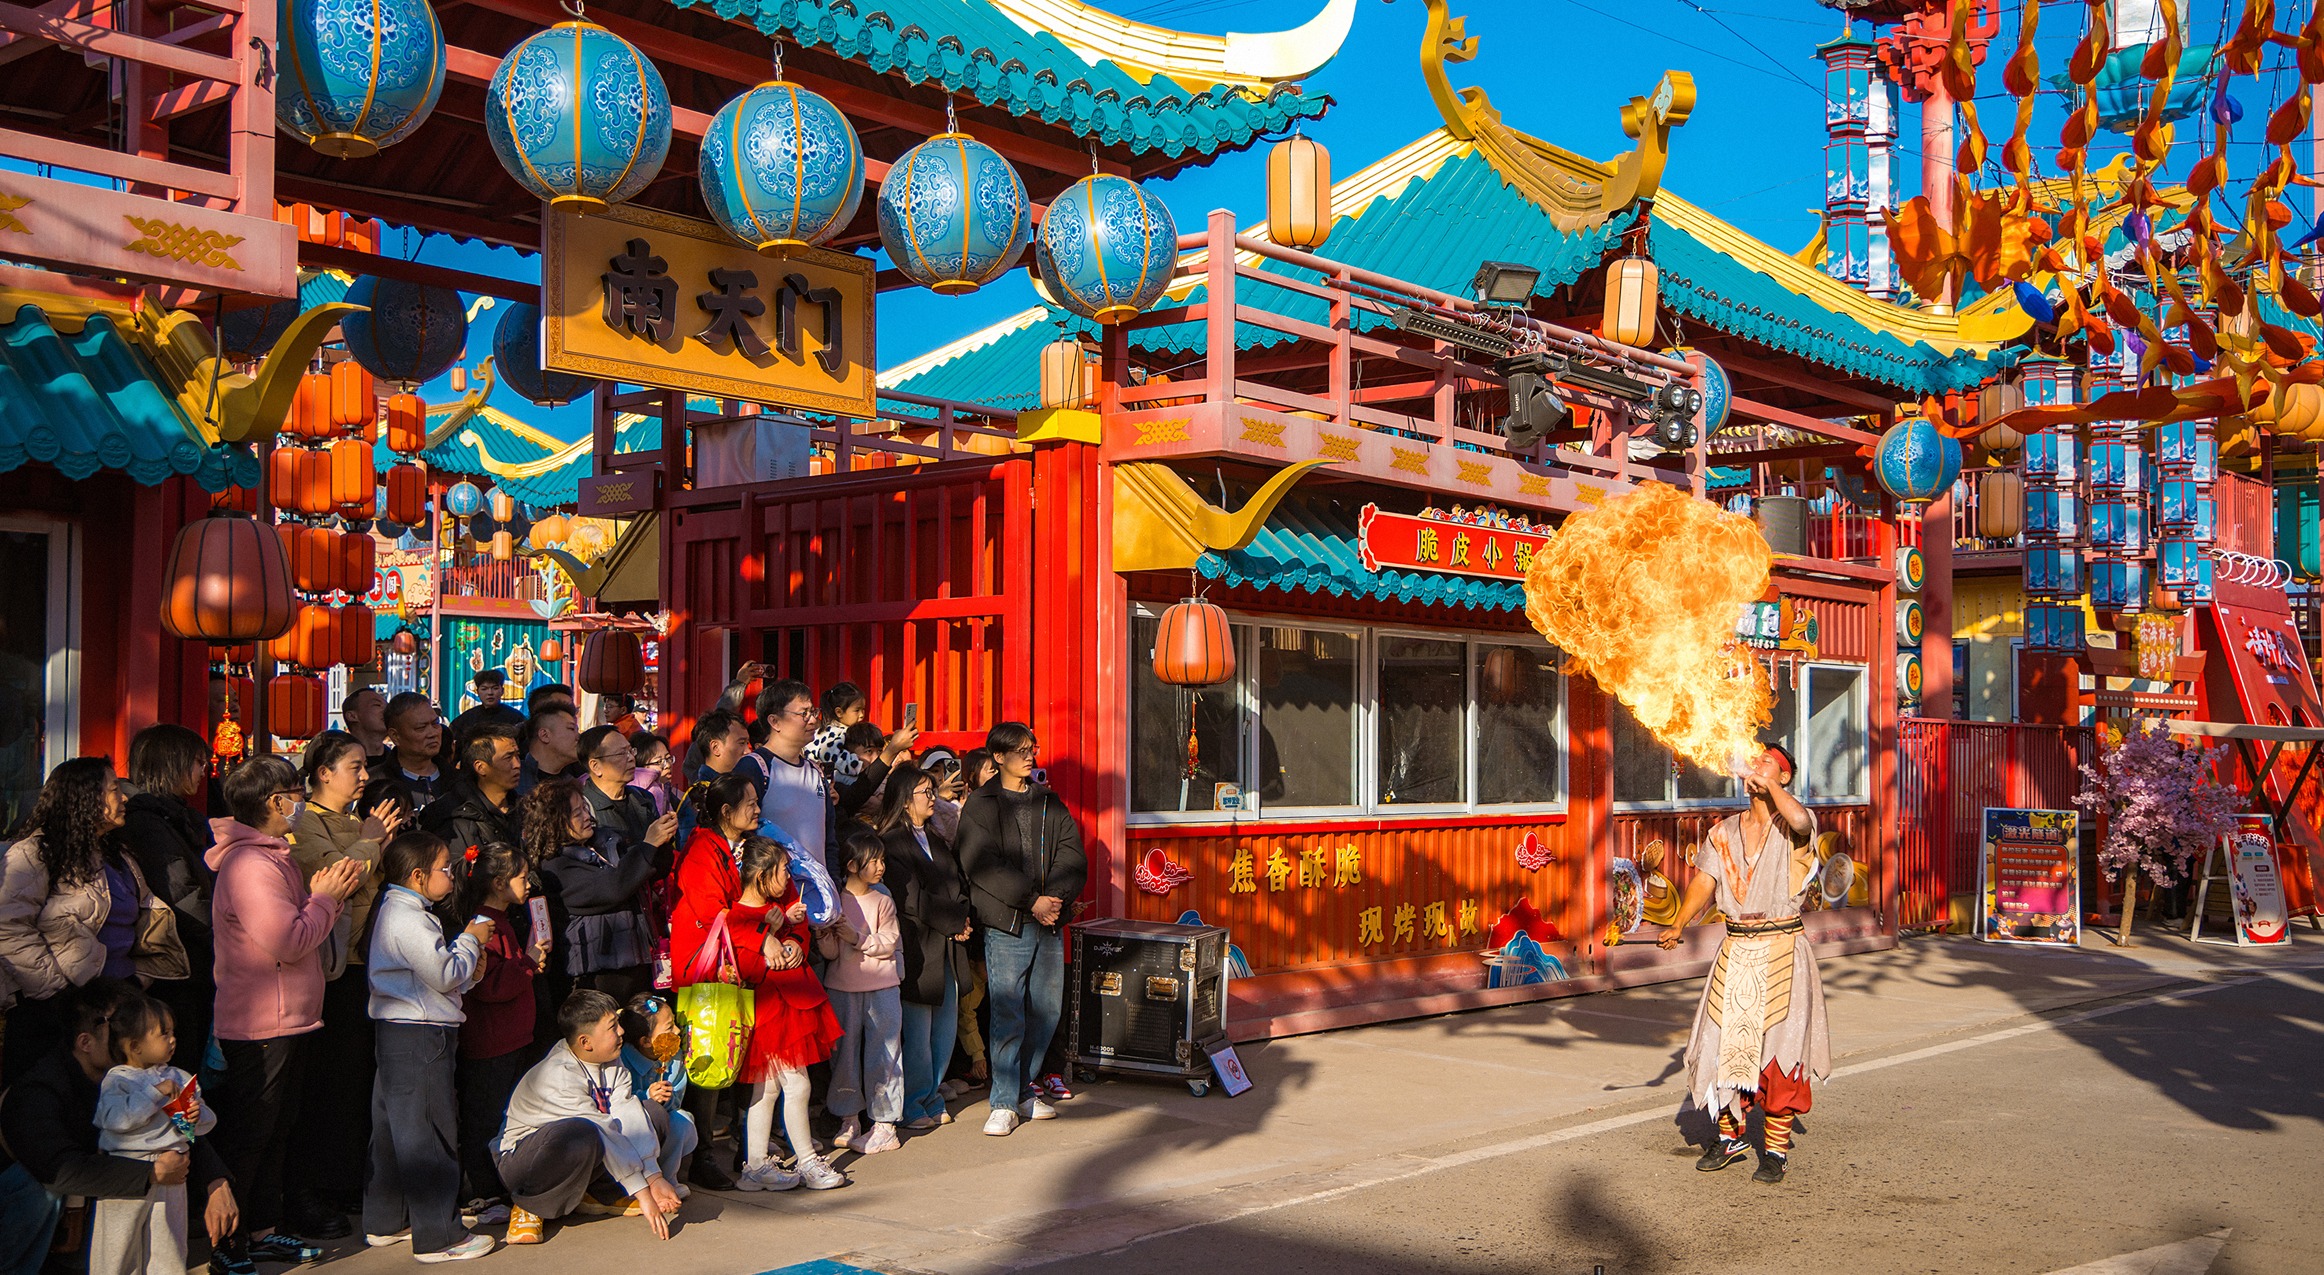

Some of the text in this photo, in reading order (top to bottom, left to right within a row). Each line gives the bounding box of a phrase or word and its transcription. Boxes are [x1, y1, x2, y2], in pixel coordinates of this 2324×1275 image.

[601, 237, 843, 373] 南天门
[2003, 827, 2059, 841] 激光隧道
[1228, 843, 1362, 894] 焦香酥脆
